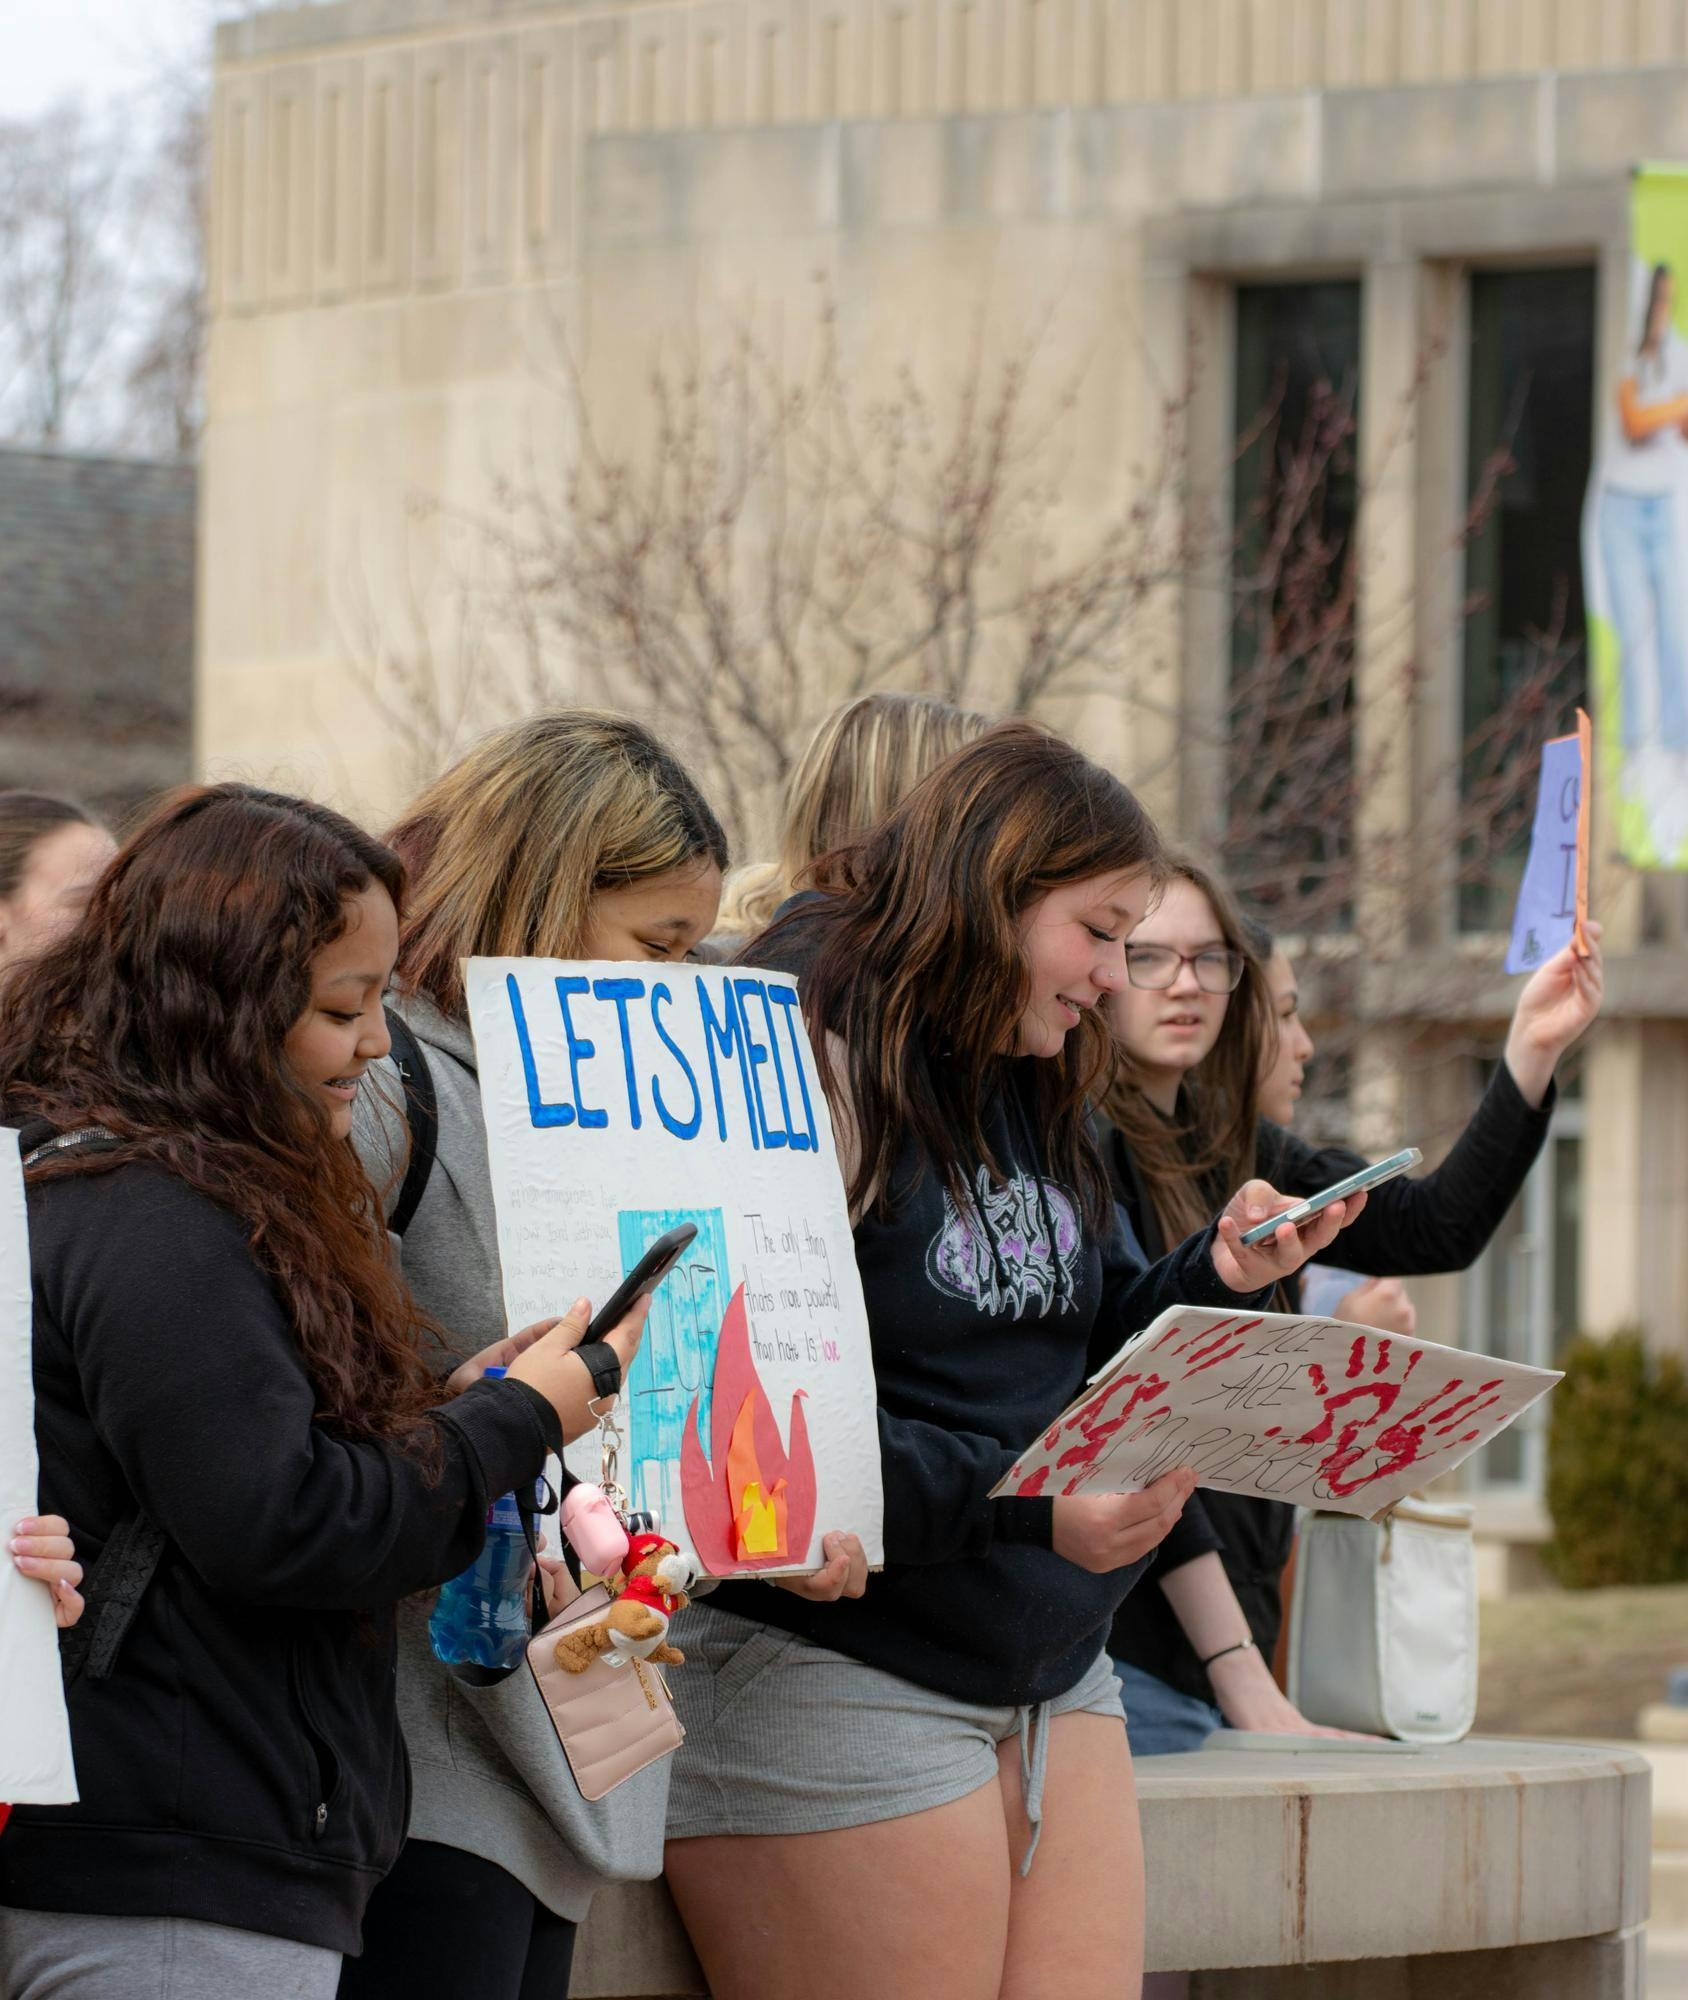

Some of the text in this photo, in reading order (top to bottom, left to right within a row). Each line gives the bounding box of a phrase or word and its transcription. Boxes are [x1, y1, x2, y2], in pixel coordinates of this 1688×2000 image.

[506, 973, 819, 1153] LETS MELT
[743, 1213, 776, 1255] The
[775, 1327, 799, 1362] hate
[1240, 1321, 1343, 1359] ICE
[1191, 1362, 1313, 1411] ARE
